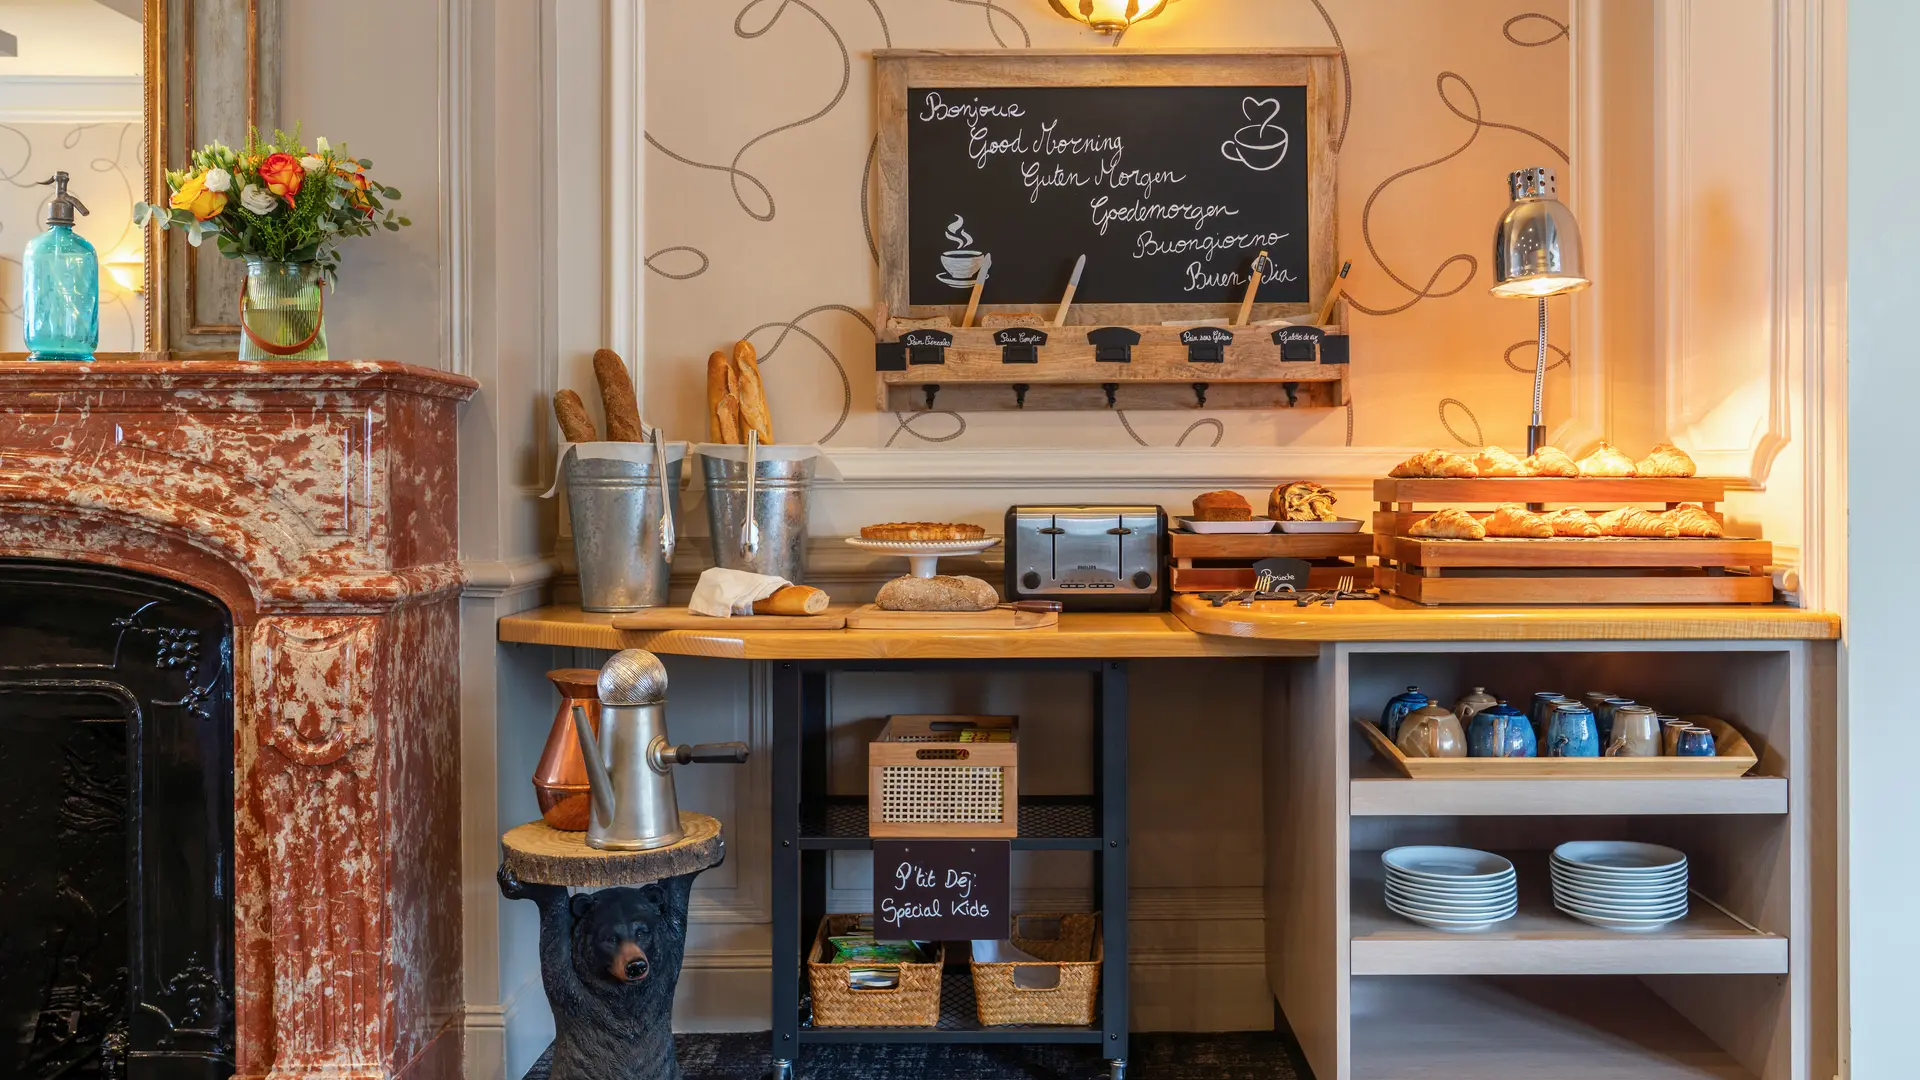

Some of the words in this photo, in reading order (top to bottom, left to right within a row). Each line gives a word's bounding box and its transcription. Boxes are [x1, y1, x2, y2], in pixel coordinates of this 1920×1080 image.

[919, 91, 1026, 128] Bonjour
[968, 126, 1029, 169] Good
[1032, 118, 1125, 167] Morning
[1020, 161, 1091, 204] Guten
[1094, 157, 1187, 200] Morgen
[1090, 195, 1240, 236] Goedemorgen
[1132, 230, 1290, 262] Buongiorno
[1183, 261, 1247, 292] Buen
[906, 334, 924, 346] Pain
[1000, 332, 1017, 343] Pain
[1018, 331, 1042, 345] Complet
[1183, 331, 1199, 343] Pain
[1212, 330, 1233, 344] Gluten
[1303, 333, 1309, 341] de
[894, 861, 937, 891] P'tit
[881, 897, 943, 928] Spécial
[951, 899, 990, 918] Kids
